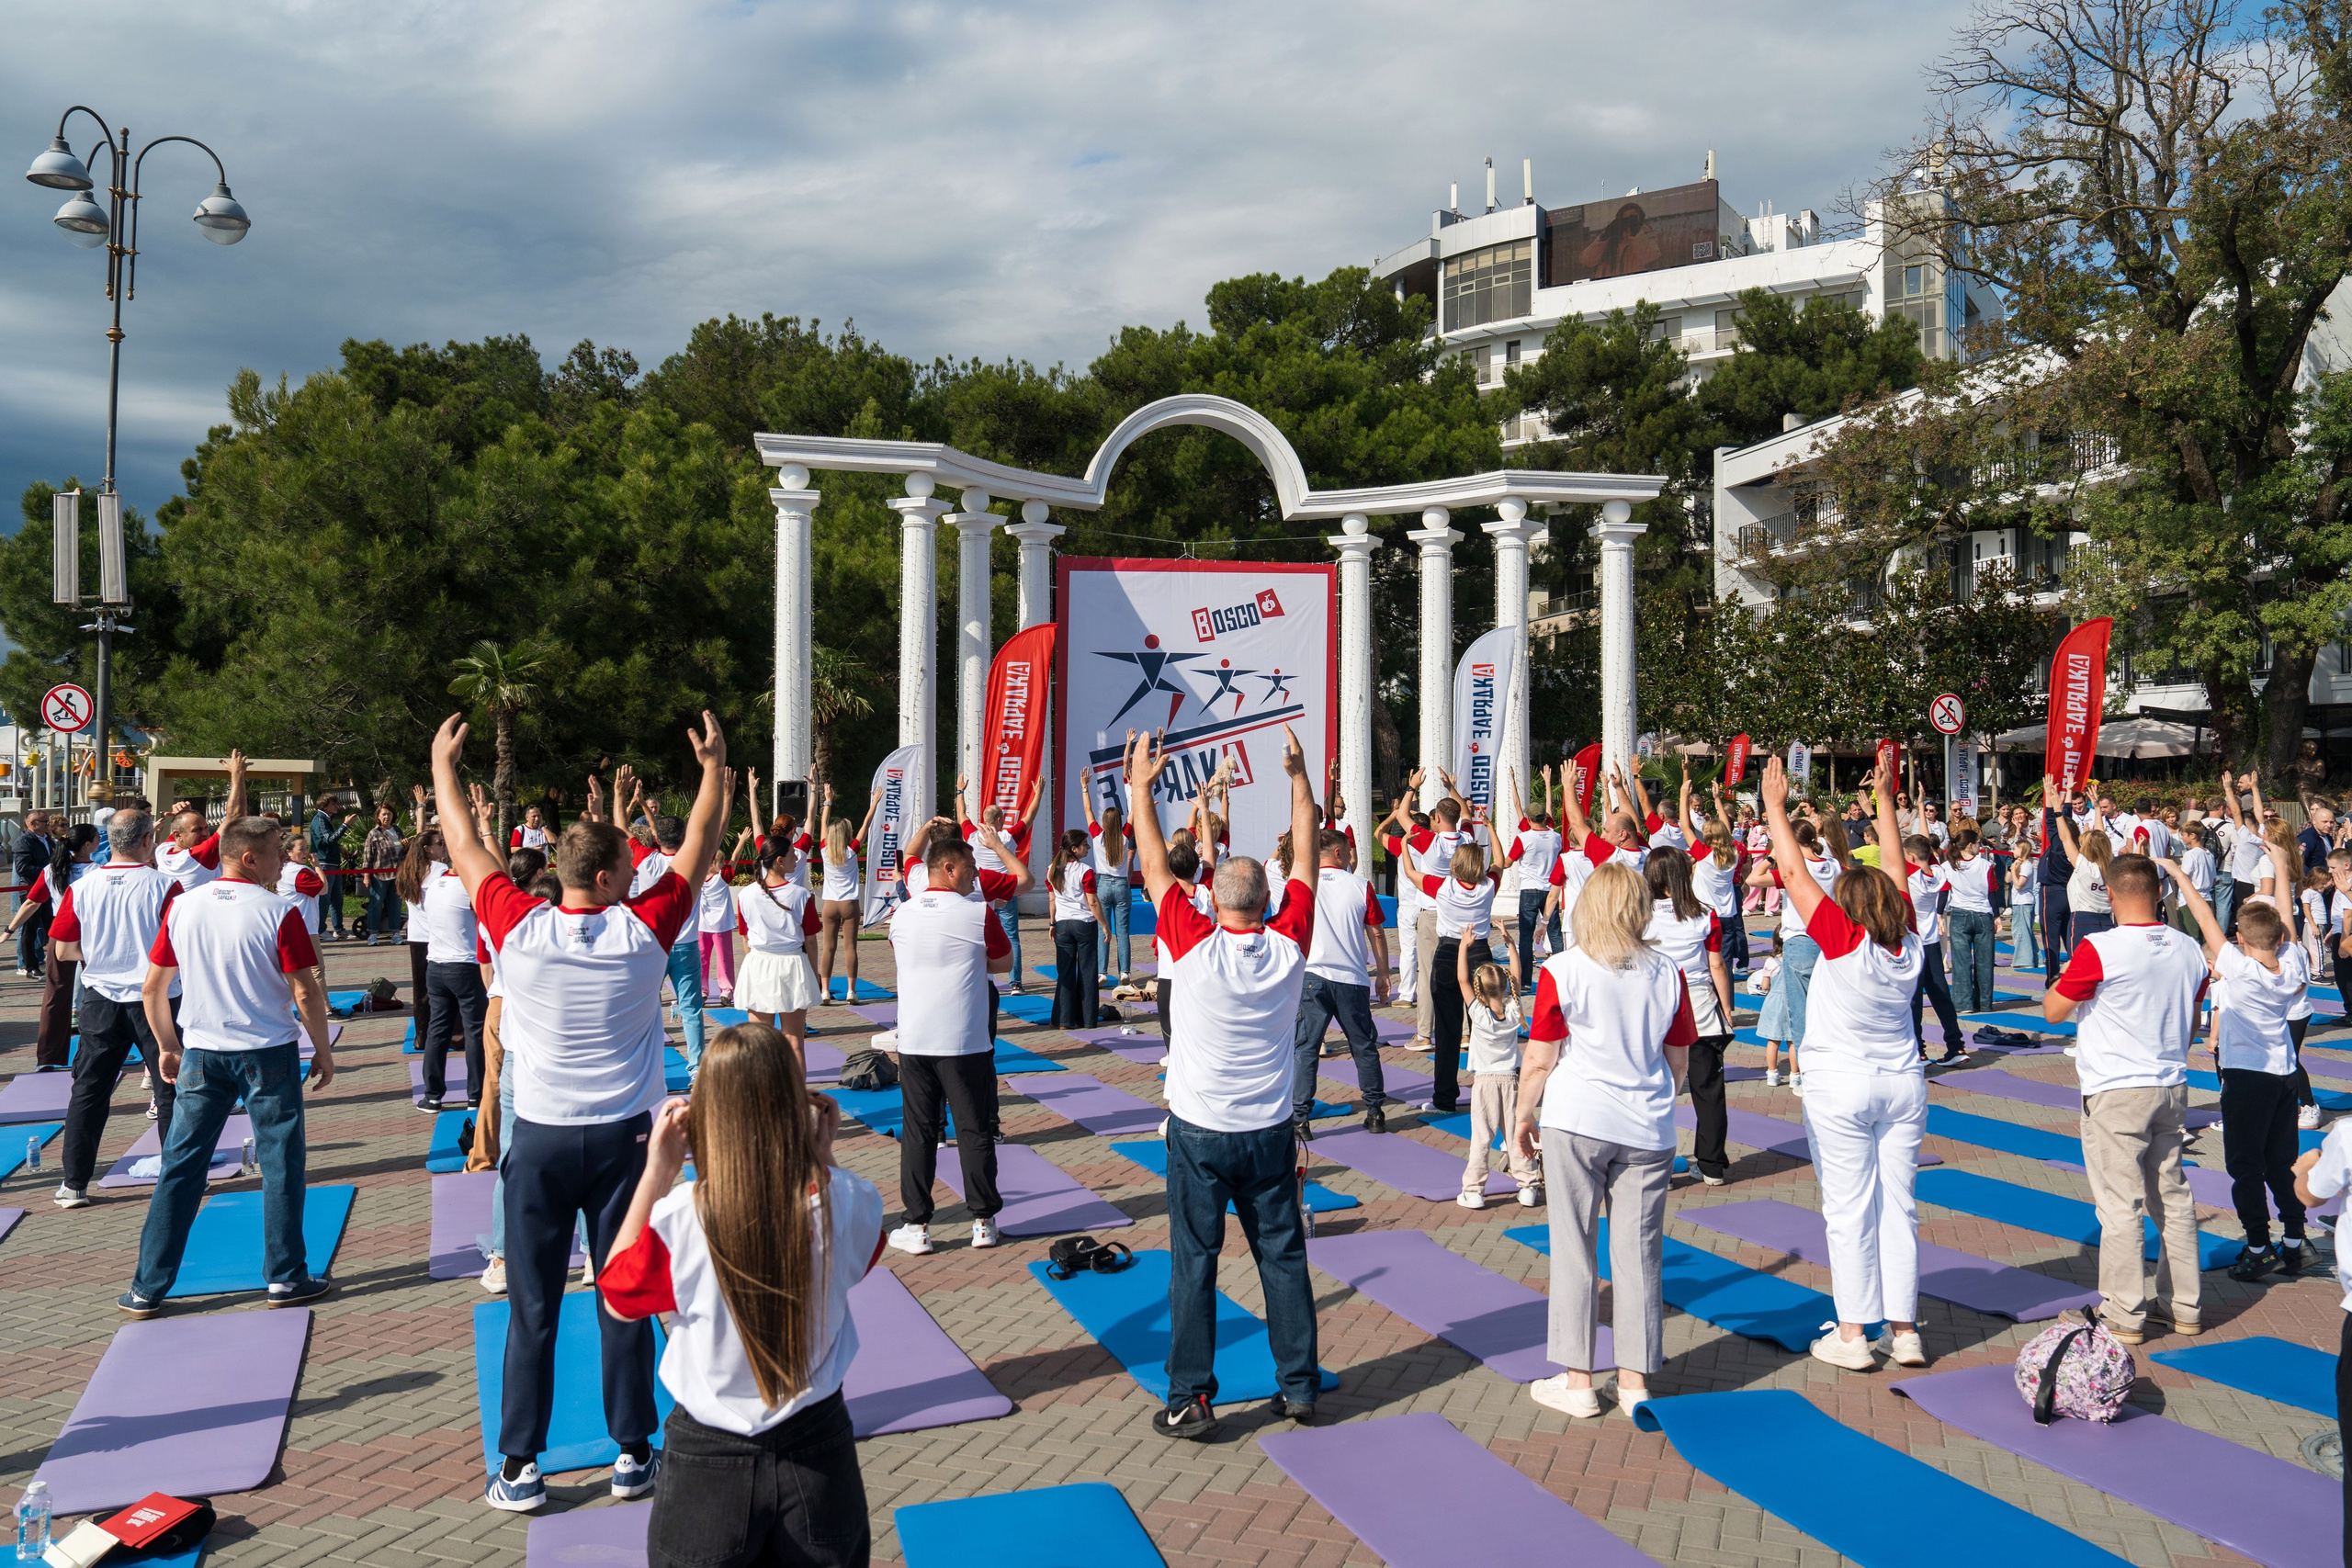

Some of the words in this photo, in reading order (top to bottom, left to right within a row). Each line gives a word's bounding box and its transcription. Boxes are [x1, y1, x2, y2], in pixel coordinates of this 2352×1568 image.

[1001, 661, 1031, 739] ЗАРЯДКА
[1472, 664, 1495, 739] ЗАРЯДКА
[2066, 653, 2090, 735] ЗАРЯДКА
[885, 769, 904, 822] ЗАРЯДКА
[1958, 779, 1972, 807] BOSCO
